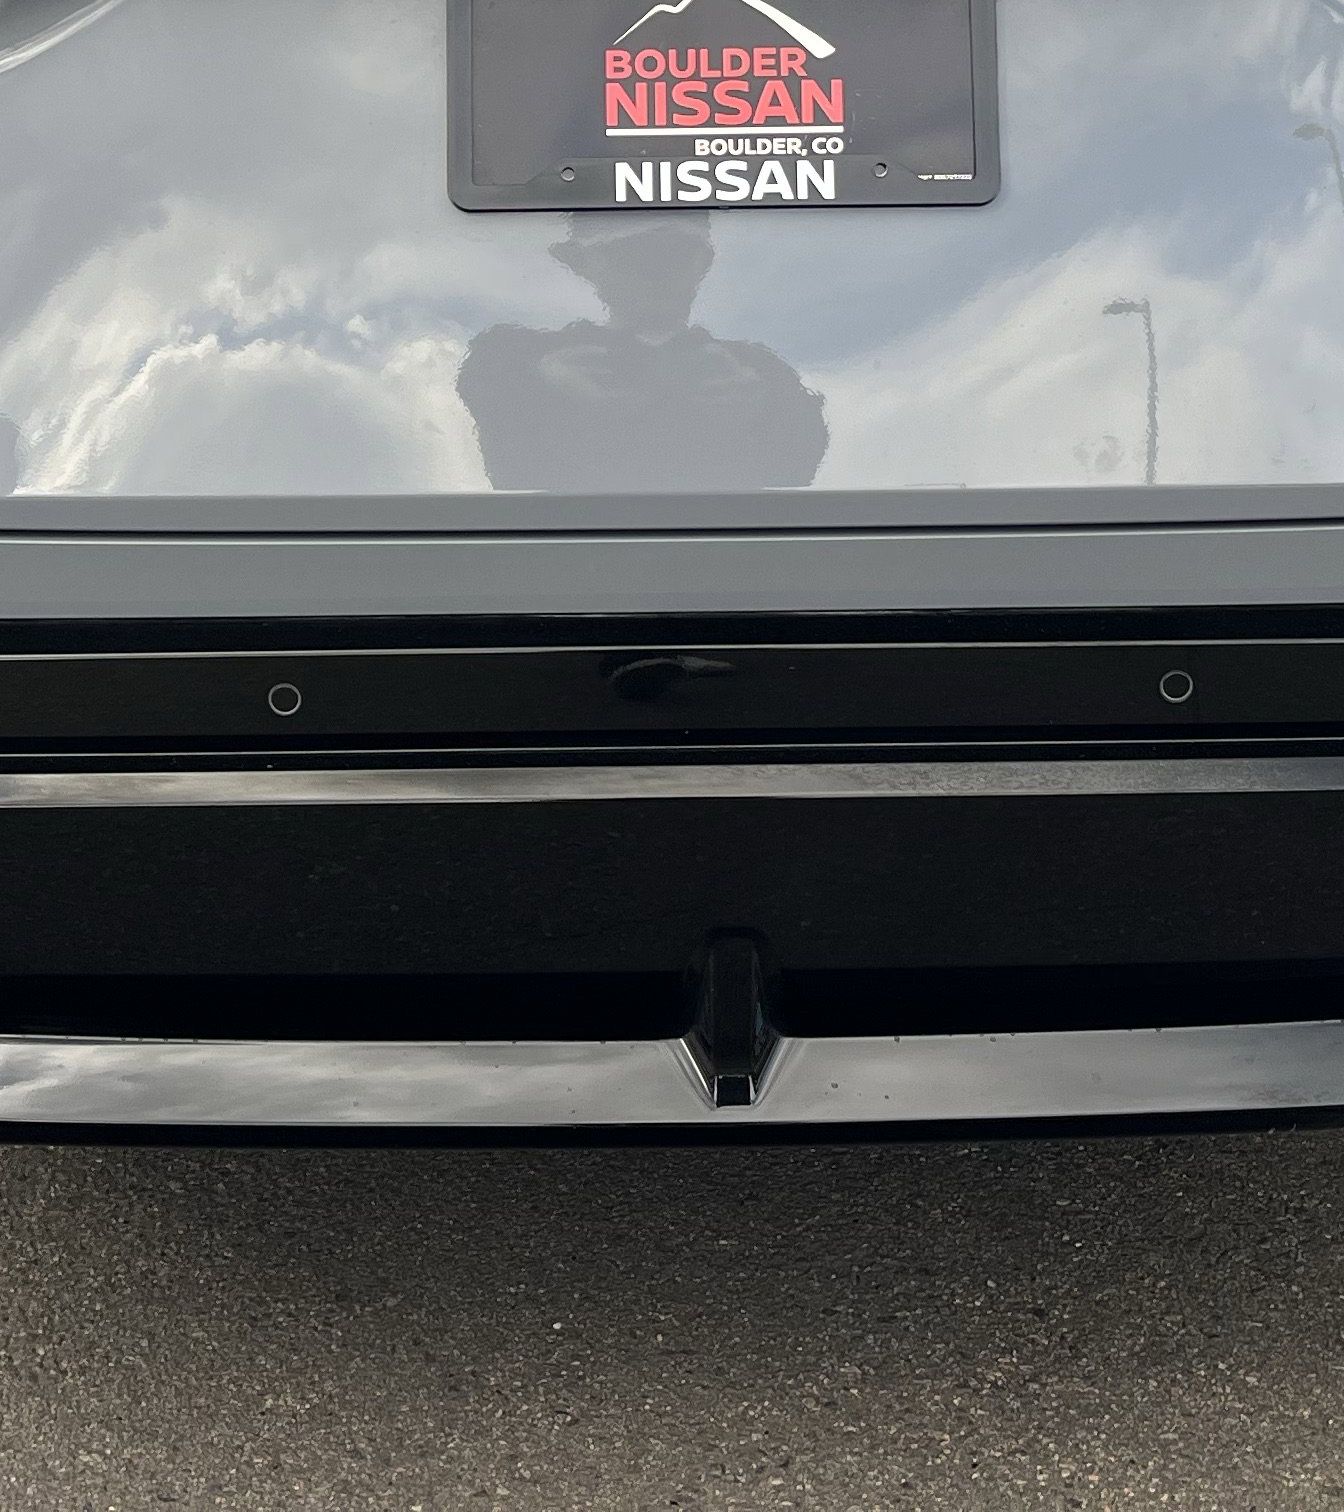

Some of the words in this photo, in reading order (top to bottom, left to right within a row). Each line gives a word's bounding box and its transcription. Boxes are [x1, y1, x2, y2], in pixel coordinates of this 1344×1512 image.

[605, 46, 807, 79] BOULDER
[605, 79, 844, 127] NISSAN
[694, 138, 808, 157] BOULDER,
[812, 137, 844, 155] CO
[614, 159, 837, 203] NISSAN
